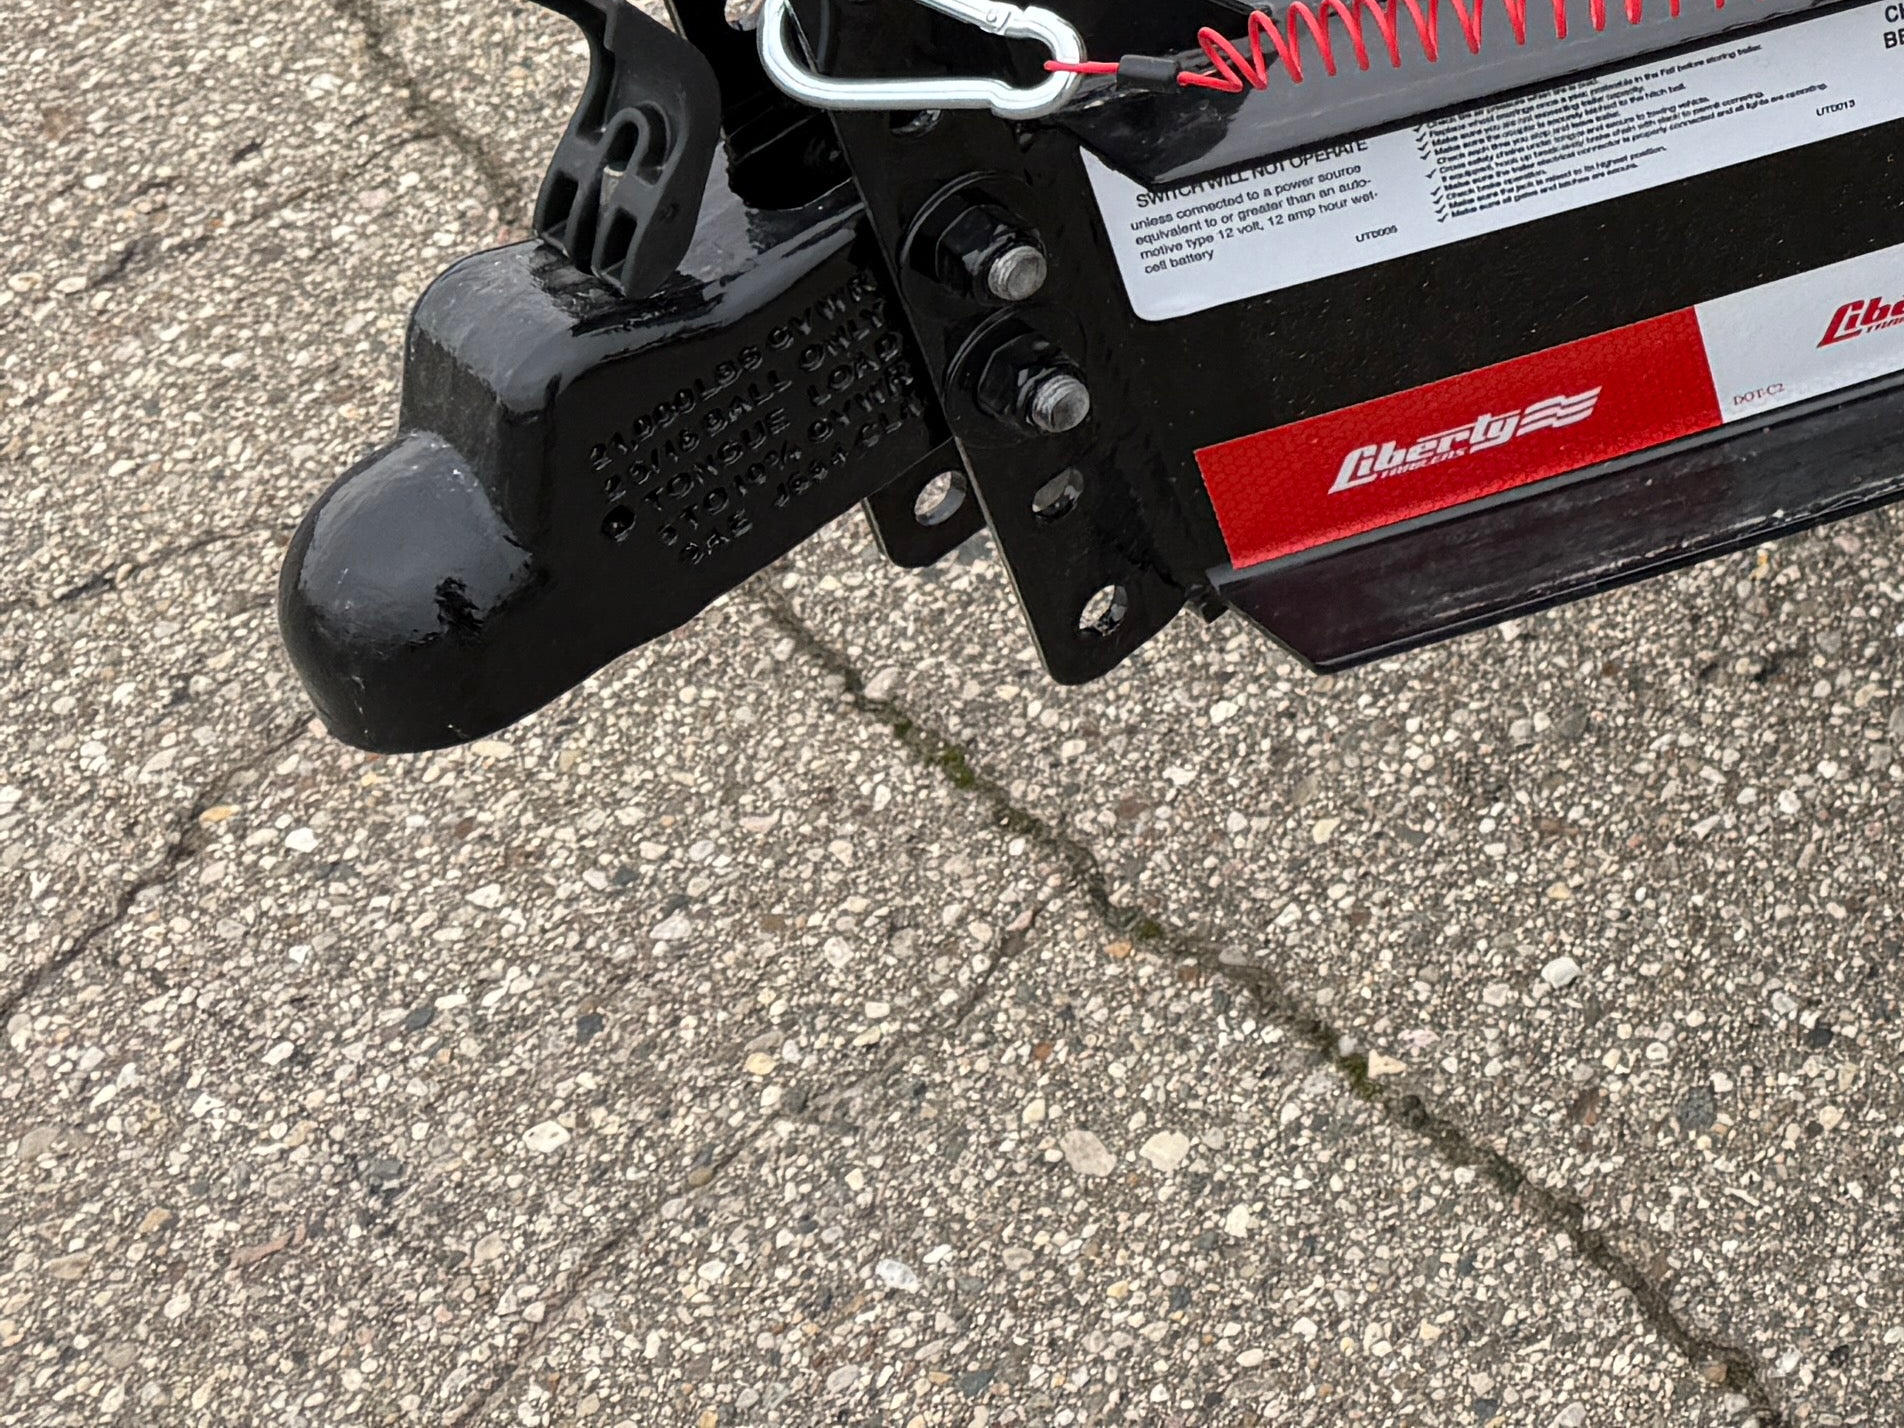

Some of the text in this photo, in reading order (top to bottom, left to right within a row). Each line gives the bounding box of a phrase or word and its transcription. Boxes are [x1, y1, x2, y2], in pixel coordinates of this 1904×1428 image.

[1130, 164, 1361, 232] unless connected to a power source
[1134, 218, 1203, 248] equivalent
[1204, 217, 1218, 228] to
[1220, 214, 1234, 224] or
[1237, 199, 1285, 221] greater
[1285, 190, 1316, 206] than
[1318, 186, 1335, 197] an
[1139, 241, 1183, 261] motive
[1185, 233, 1215, 250] type
[1218, 228, 1234, 239] 12
[1267, 215, 1283, 226] 12
[1286, 207, 1317, 224] amp
[1318, 197, 1348, 213] hour
[1143, 247, 1216, 274] cell battery
[1326, 409, 1522, 495] Liberty
